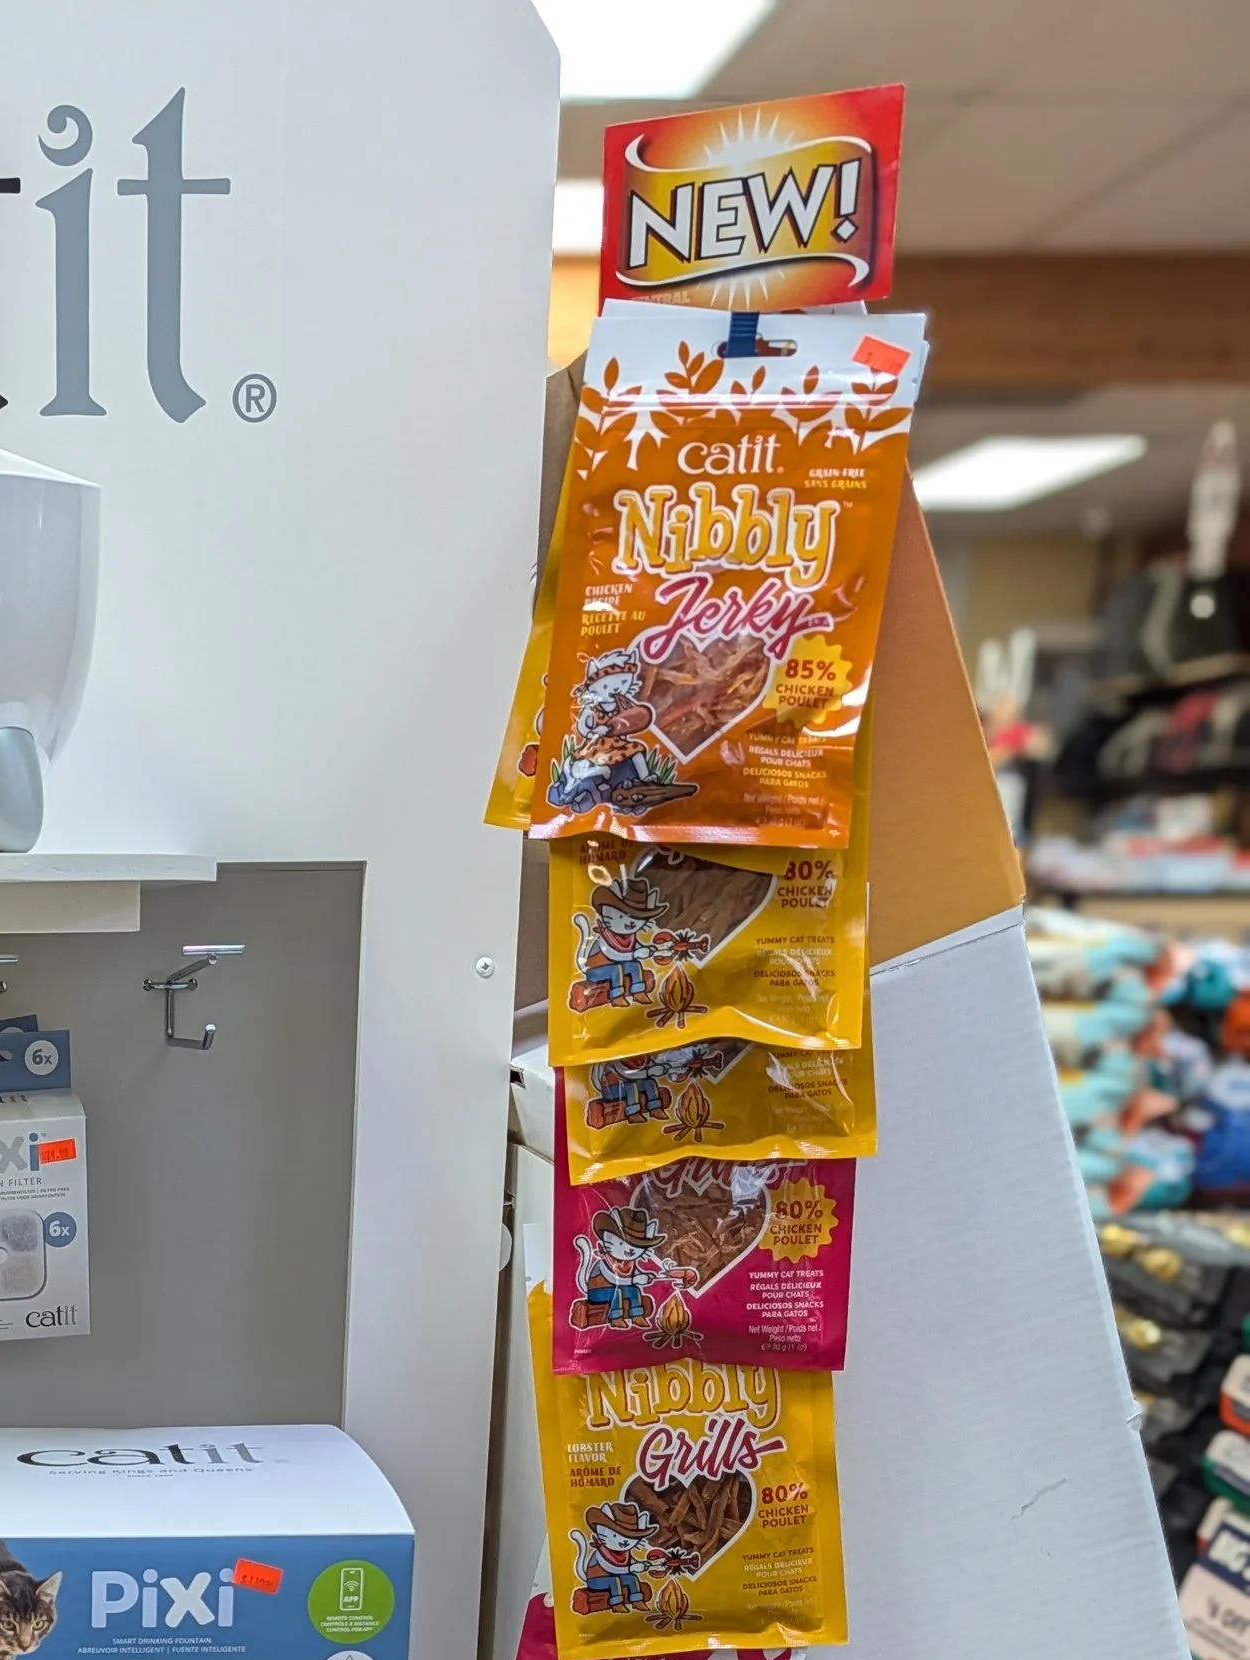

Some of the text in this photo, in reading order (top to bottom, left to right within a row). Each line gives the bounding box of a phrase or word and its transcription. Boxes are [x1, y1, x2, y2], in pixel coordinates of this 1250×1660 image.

[629, 158, 861, 269] NEW!
[678, 434, 781, 475] catit
[809, 468, 866, 478] GRAIN-FREE
[612, 482, 839, 590] Nibbly
[585, 584, 632, 596] CHICKEN
[631, 611, 646, 620] AU
[643, 575, 832, 662] Jerky
[581, 623, 621, 636] POULET
[784, 659, 836, 681] 85%
[775, 684, 834, 697] CHICKEN
[778, 696, 828, 710] POULET
[778, 886, 833, 897] CHICKEN
[32, 1049, 52, 1065] 6x
[9, 1178, 42, 1186] FILTER
[776, 1201, 823, 1220] 80%
[49, 1221, 70, 1237] 6x
[770, 1223, 822, 1235] CHICKEN
[774, 1234, 819, 1245] POULET
[746, 1302, 792, 1310] DELICIOSOS
[26, 1306, 77, 1329] catit
[568, 1442, 614, 1453] LOBSTER
[16, 1442, 264, 1467] catit
[569, 1453, 607, 1463] FLAVOR
[639, 1419, 786, 1490] Grills
[609, 1466, 621, 1475] DE
[761, 1483, 808, 1505] 80%
[758, 1504, 808, 1518] CHICKEN
[762, 1516, 807, 1528] POULET
[788, 1547, 814, 1555] TREATS
[91, 1568, 234, 1628] Pixi
